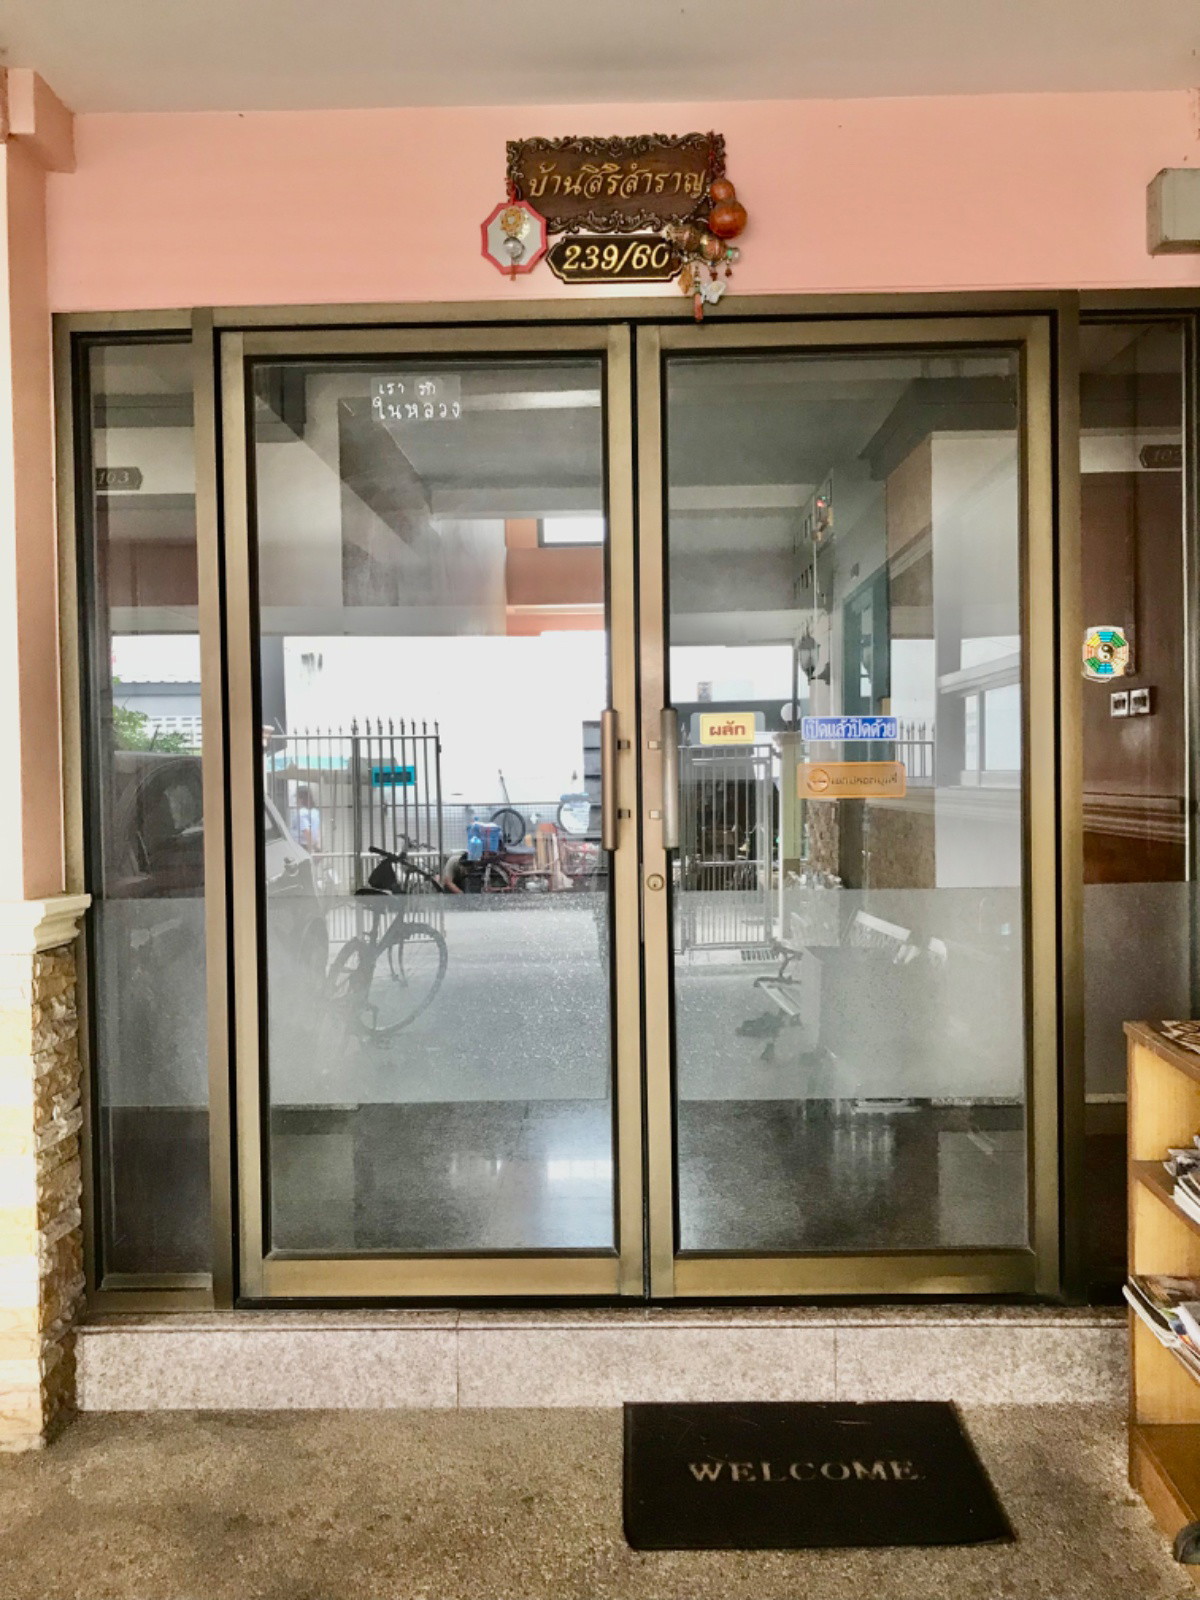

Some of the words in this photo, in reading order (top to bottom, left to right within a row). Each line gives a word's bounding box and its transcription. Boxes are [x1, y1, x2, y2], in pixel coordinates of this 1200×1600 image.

[529, 162, 706, 199] บ้านสิริสำราญ
[563, 241, 669, 272] 239/60
[379, 383, 405, 395] เรา
[709, 721, 746, 736] ผลัก
[805, 718, 896, 739] เปิดแล้วปิดด้วย
[688, 1461, 921, 1481] WELCOME
